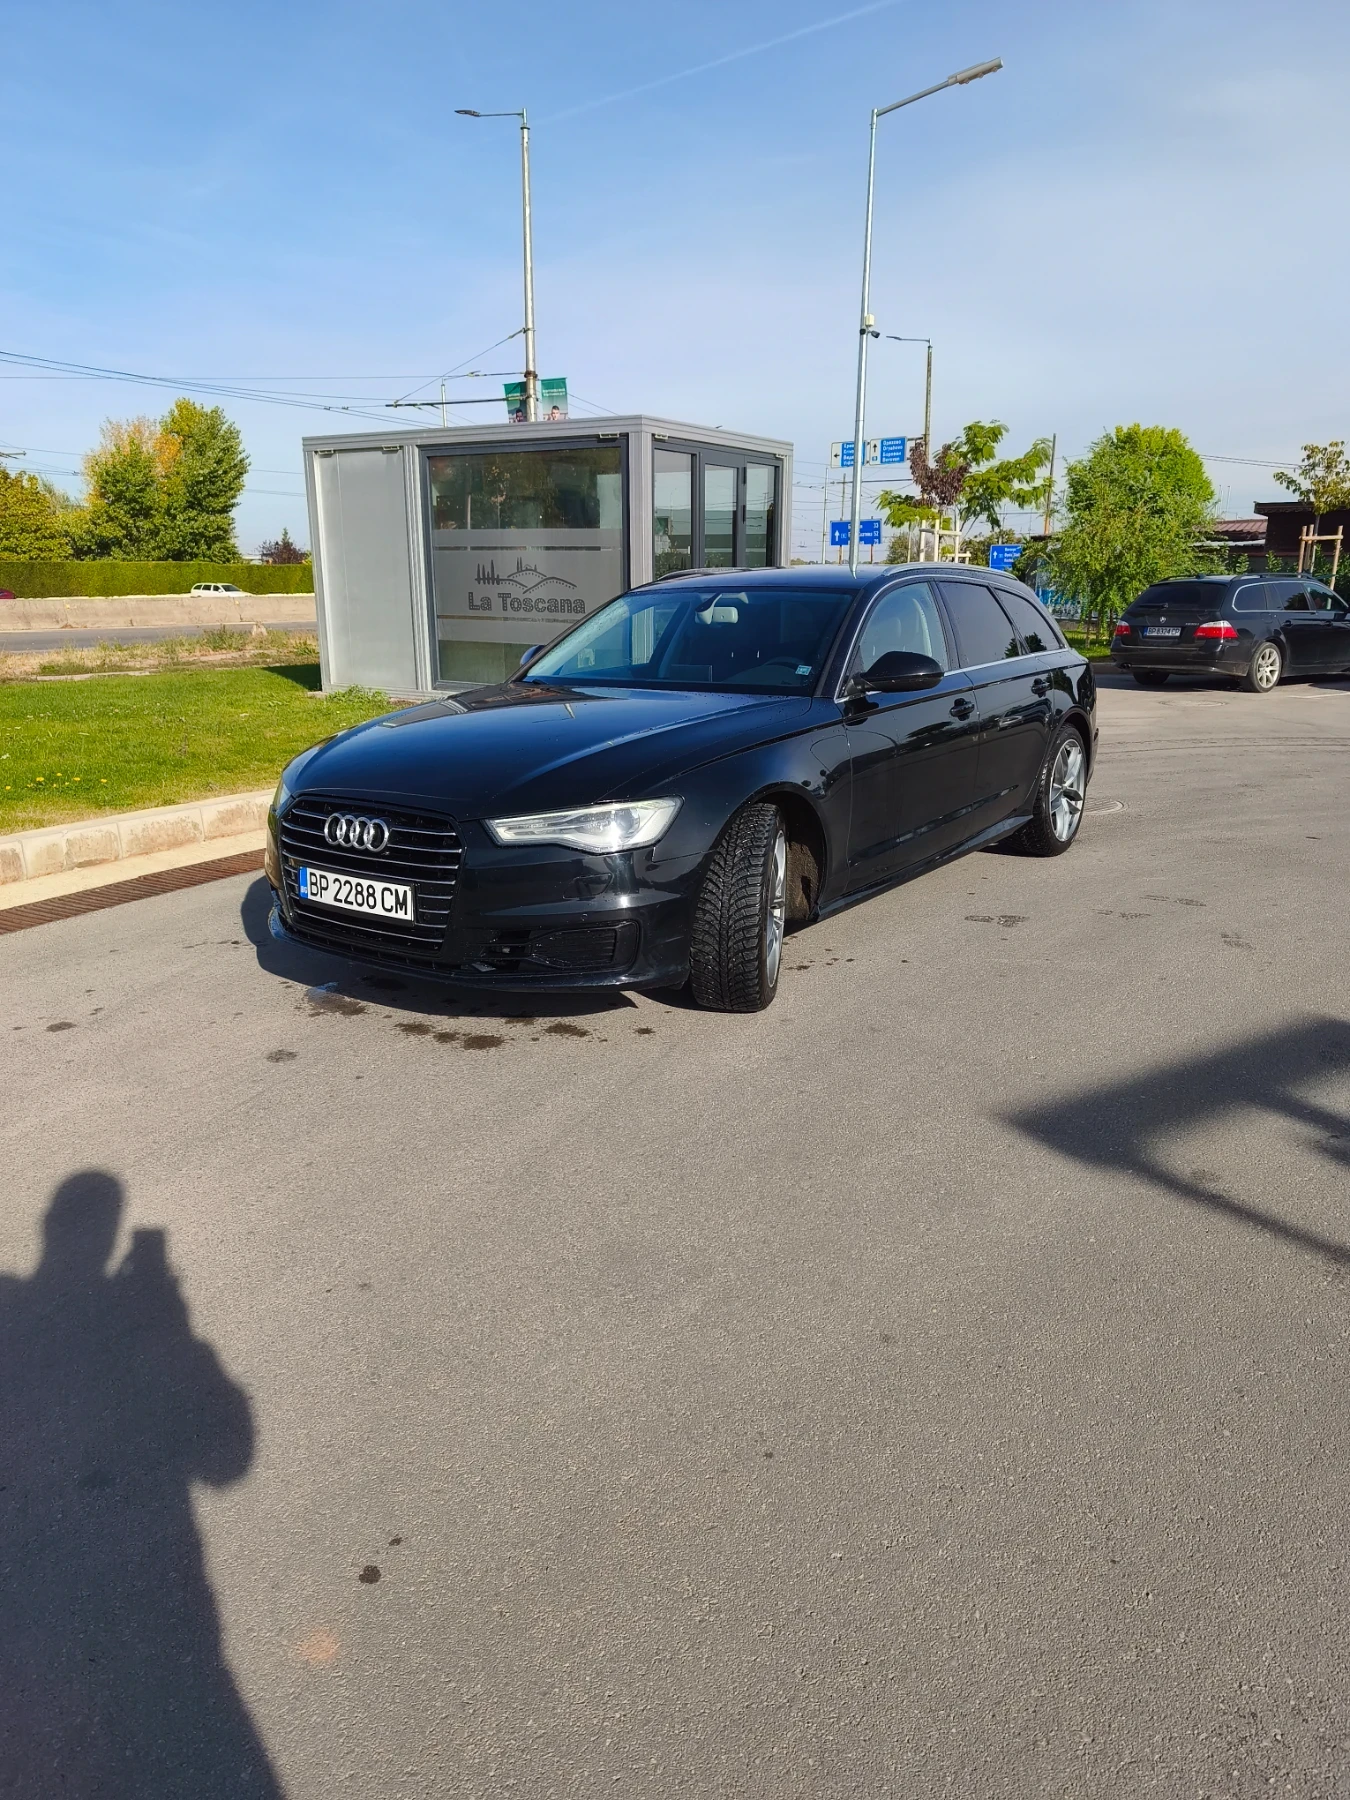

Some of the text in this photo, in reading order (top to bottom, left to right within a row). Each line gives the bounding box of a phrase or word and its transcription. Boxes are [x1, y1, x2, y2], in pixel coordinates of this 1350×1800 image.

[468, 591, 586, 614] La Toscana
[309, 871, 408, 916] BP 2288 CM
